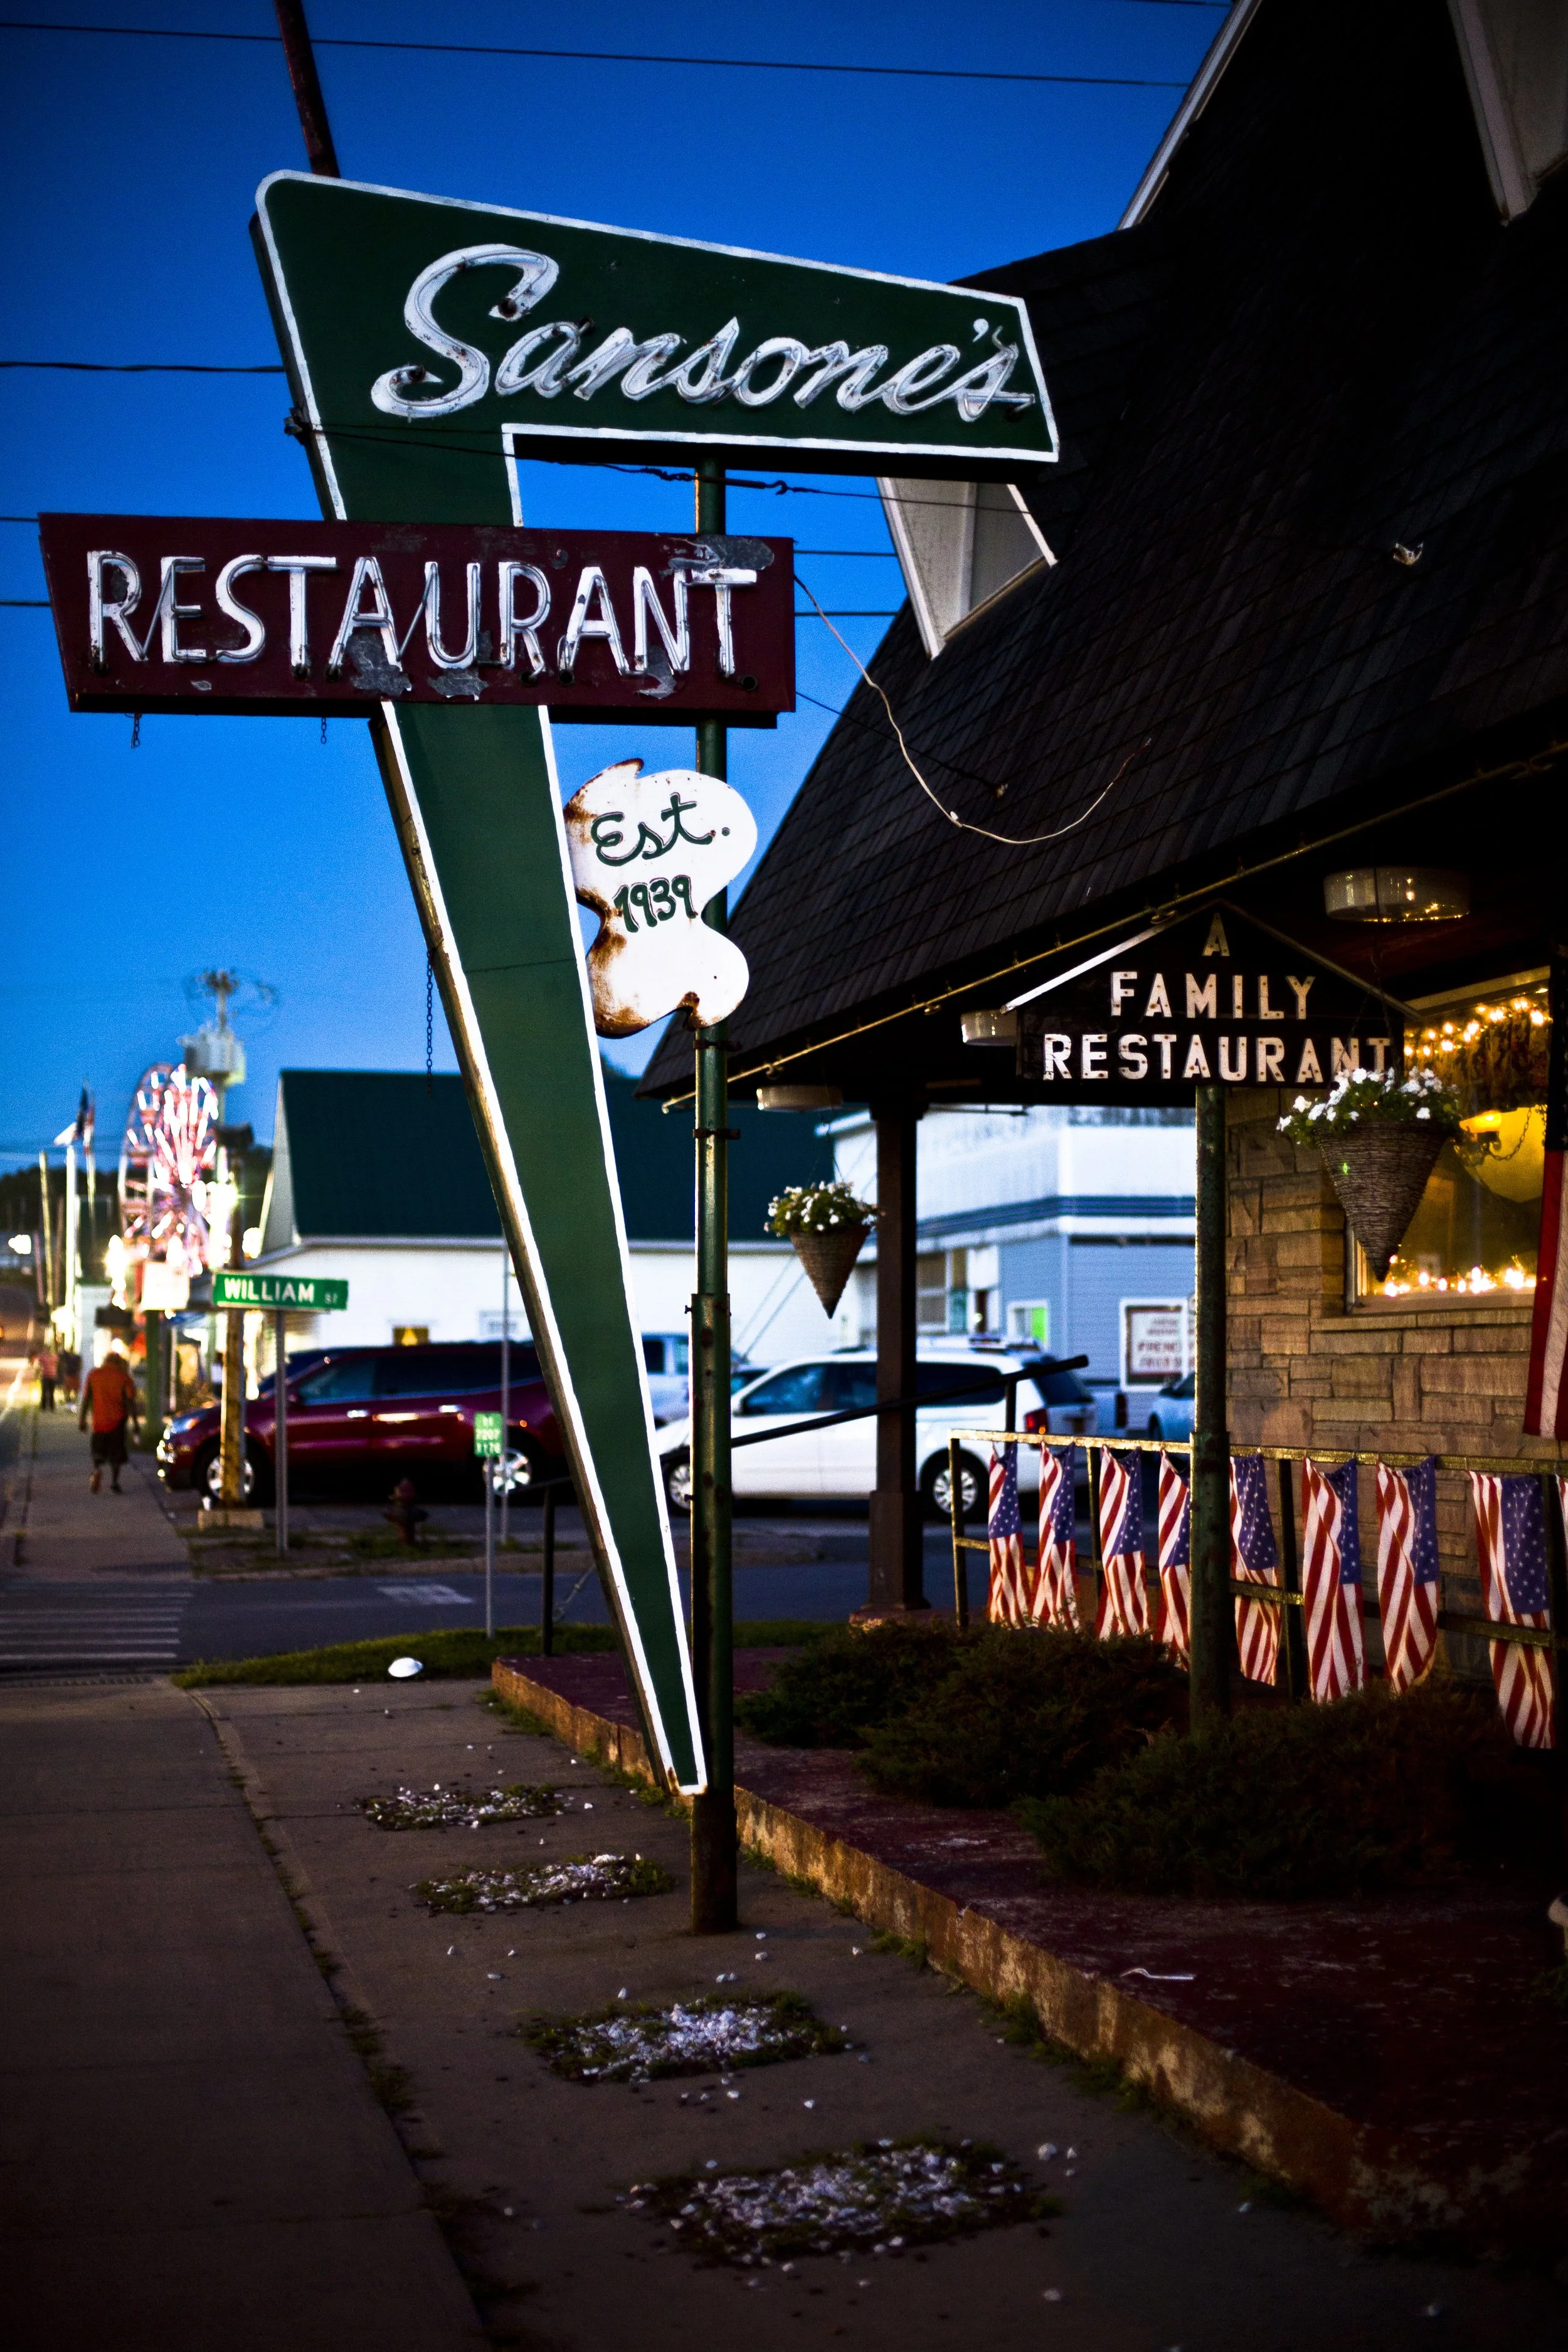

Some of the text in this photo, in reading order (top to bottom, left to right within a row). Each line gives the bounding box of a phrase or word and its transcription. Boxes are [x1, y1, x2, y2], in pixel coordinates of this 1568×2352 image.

[371, 243, 1036, 423] Sansone's
[87, 549, 758, 677] RESTAURANT
[591, 792, 731, 866] Est.
[612, 874, 698, 933] 1939
[1202, 912, 1230, 956] A
[1110, 970, 1316, 1020] FAMILY
[1043, 1033, 1391, 1084] RESTAURANT
[224, 1277, 315, 1303] WILLIAM
